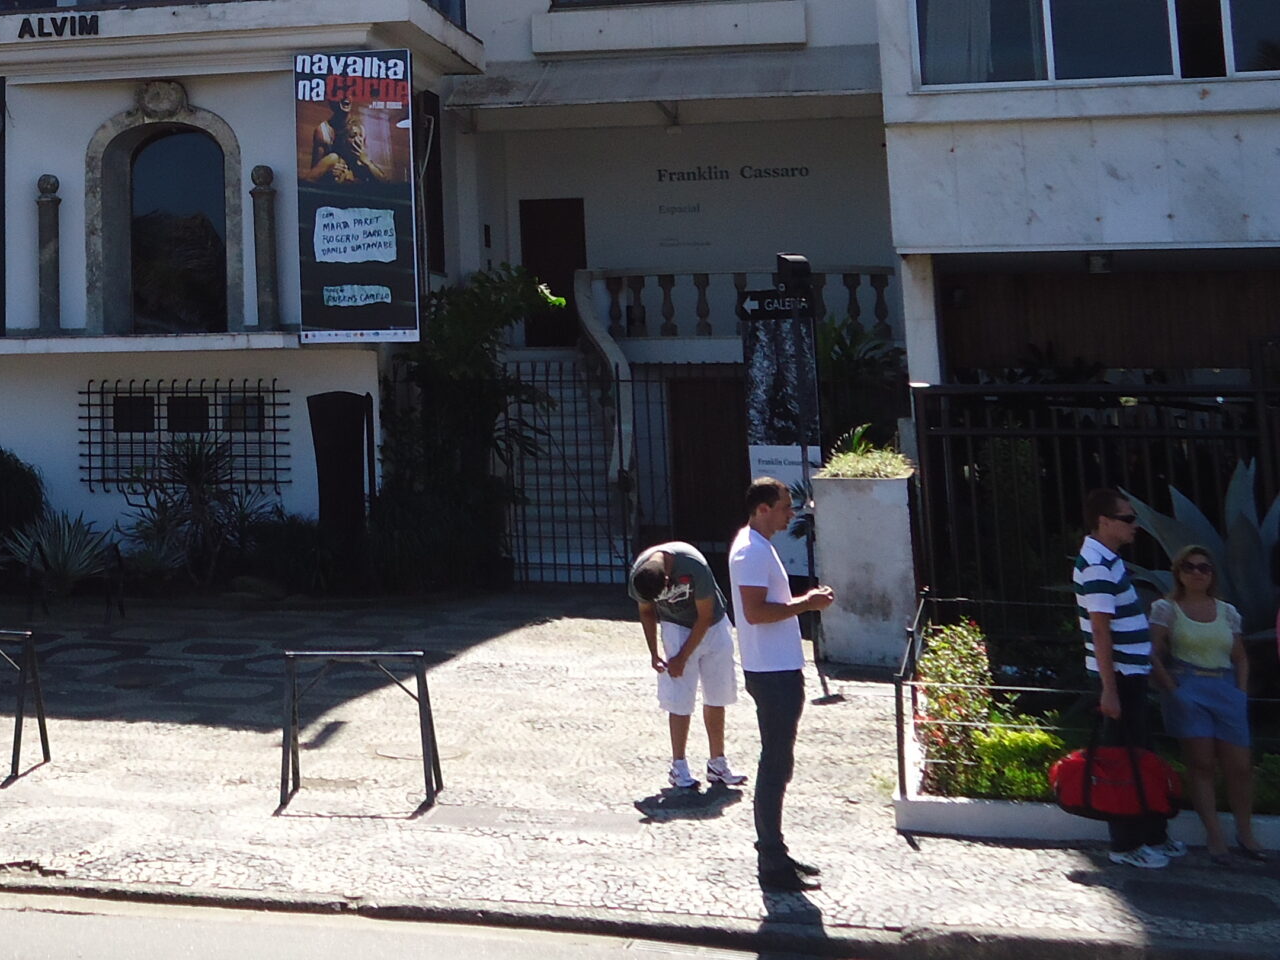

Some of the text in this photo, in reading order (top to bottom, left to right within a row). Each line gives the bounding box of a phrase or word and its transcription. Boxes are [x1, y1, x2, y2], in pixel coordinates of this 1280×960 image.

[18, 14, 99, 40] ALVIM
[295, 53, 405, 79] navalha
[297, 78, 326, 102] na
[656, 165, 810, 182] Franklin Cassaro
